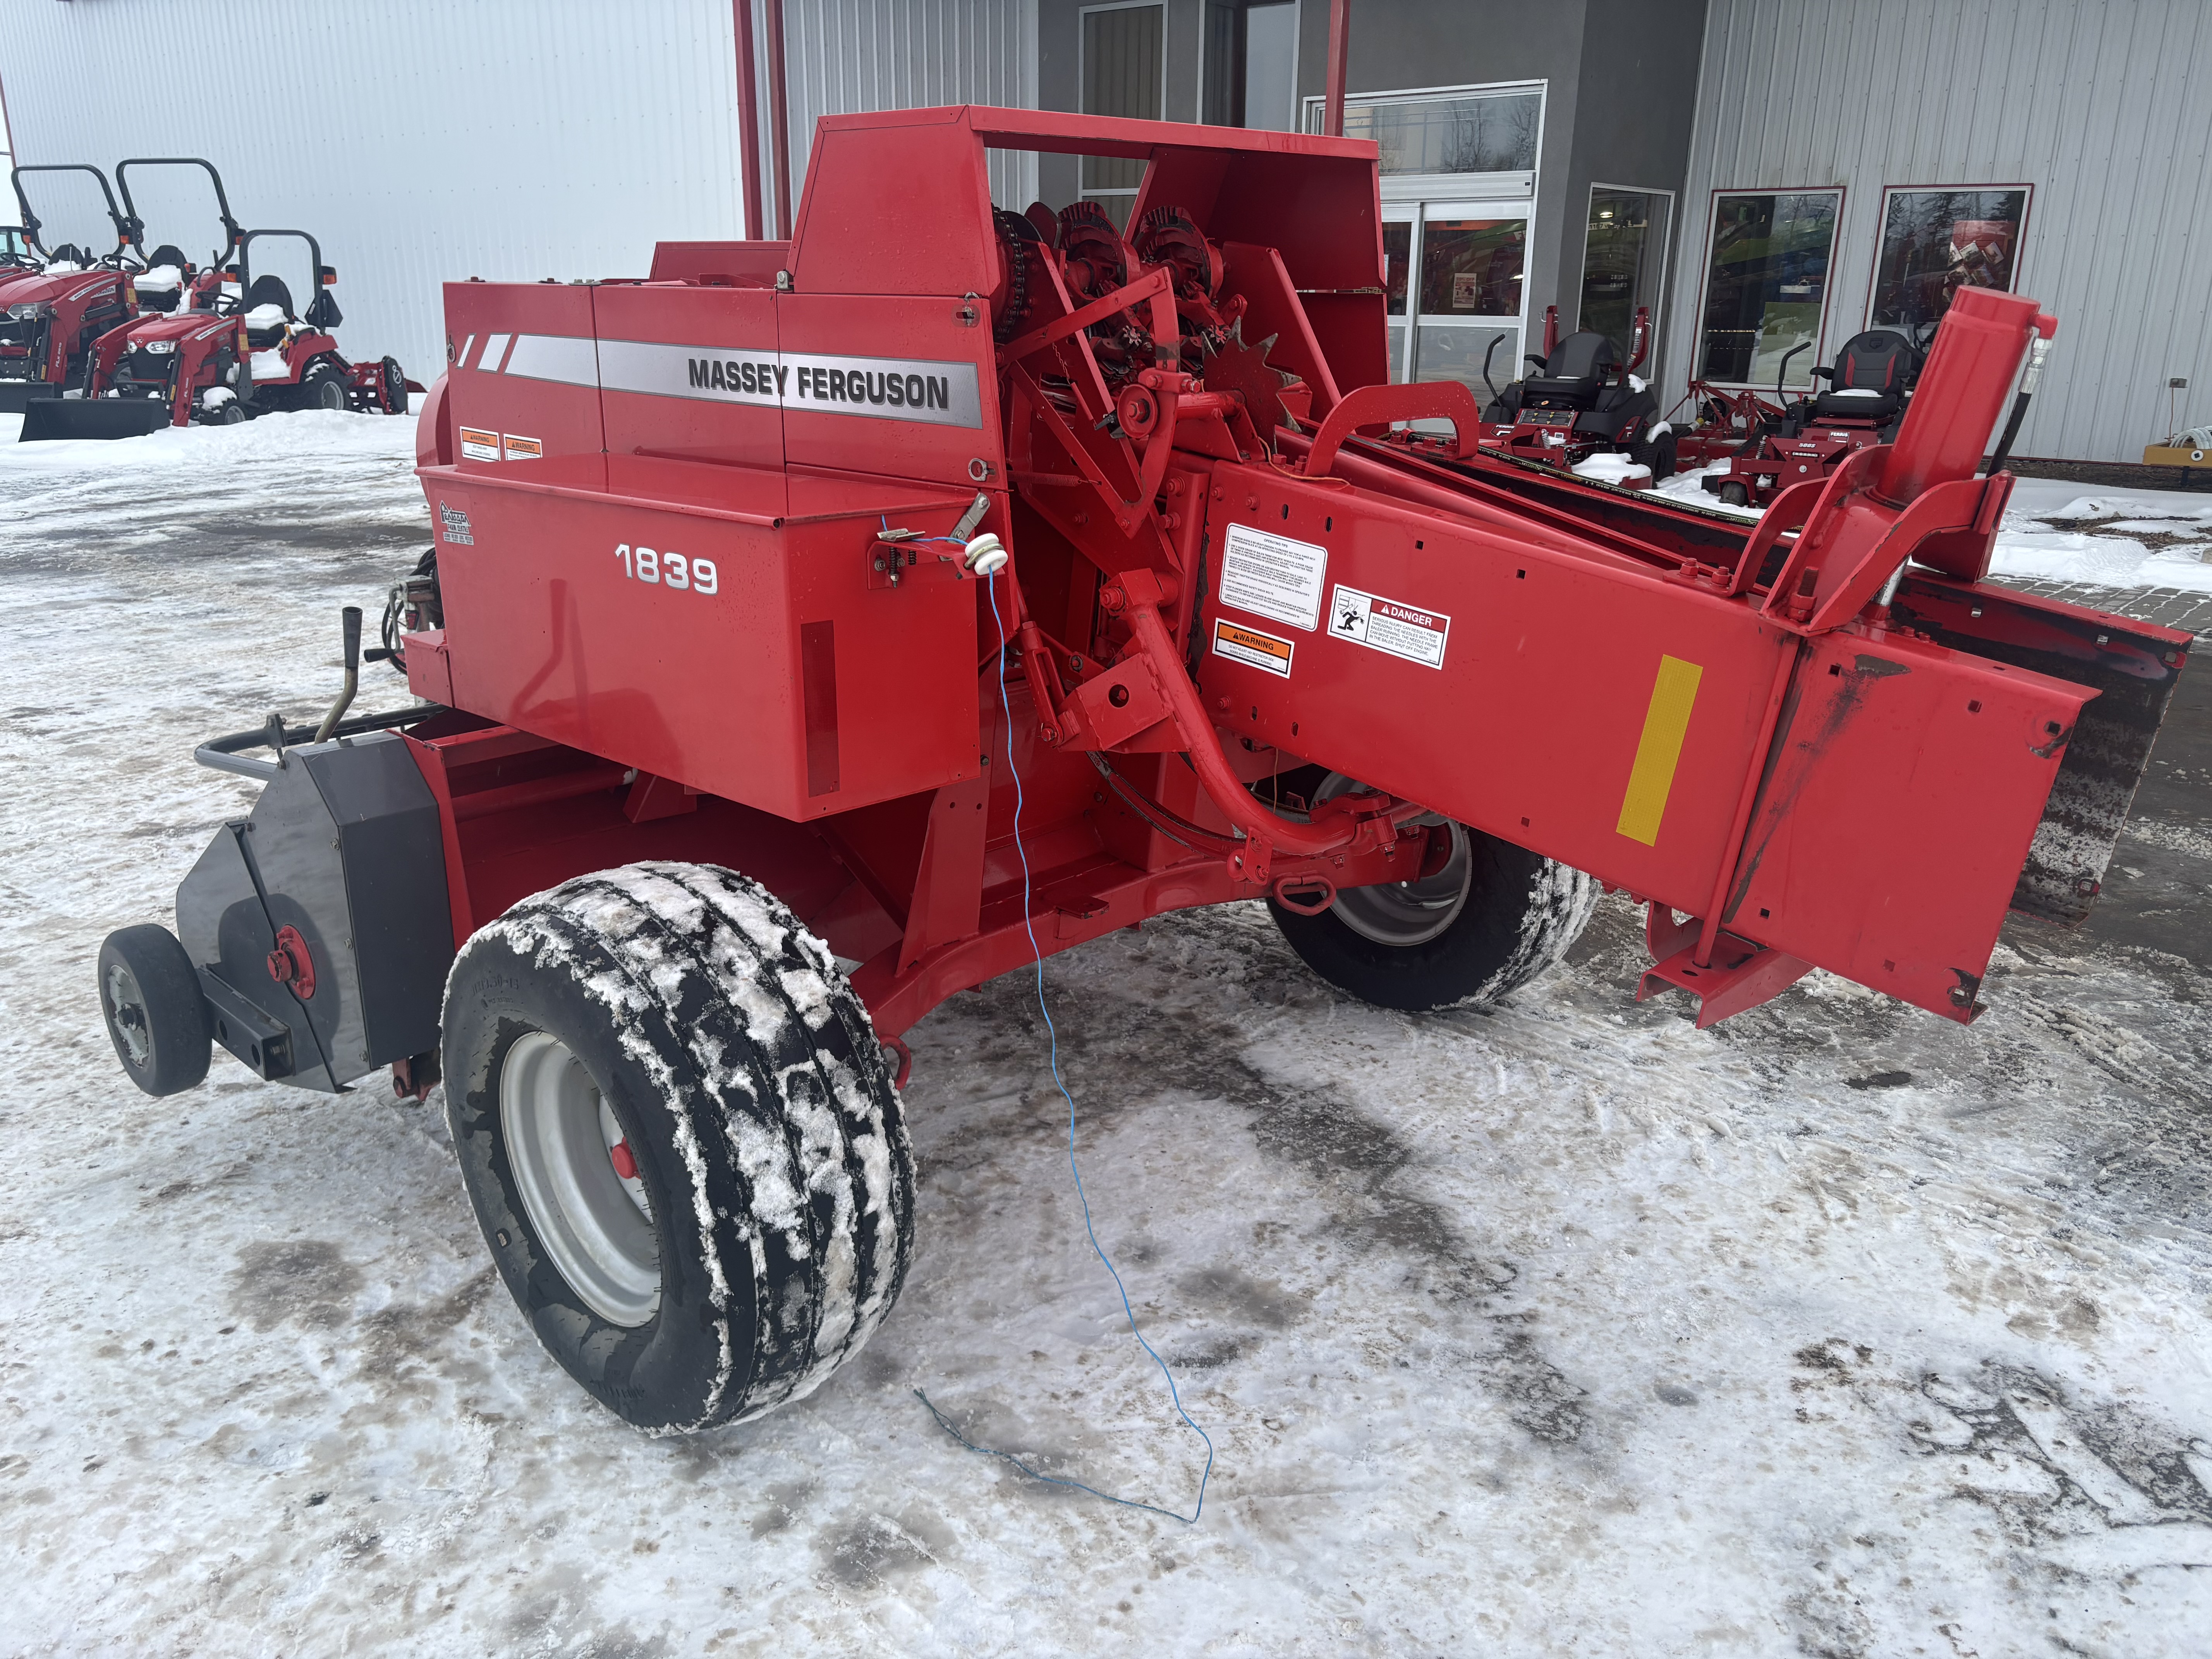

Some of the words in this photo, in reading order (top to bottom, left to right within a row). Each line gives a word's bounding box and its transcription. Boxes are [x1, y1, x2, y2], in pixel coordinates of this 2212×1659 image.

[688, 359, 789, 396] MASSEY
[797, 367, 949, 411] FERGUSON
[515, 441, 535, 451] WARNING
[1263, 538, 1281, 546] OPERATING
[615, 543, 718, 596] 1839
[1391, 607, 1432, 626] DANGER
[1372, 621, 1393, 630] THREADING
[1401, 629, 1418, 638] NEEDLES
[1238, 633, 1274, 650] WARNING
[1389, 635, 1406, 644] WITHOUT
[1407, 641, 1423, 649] PUTTING
